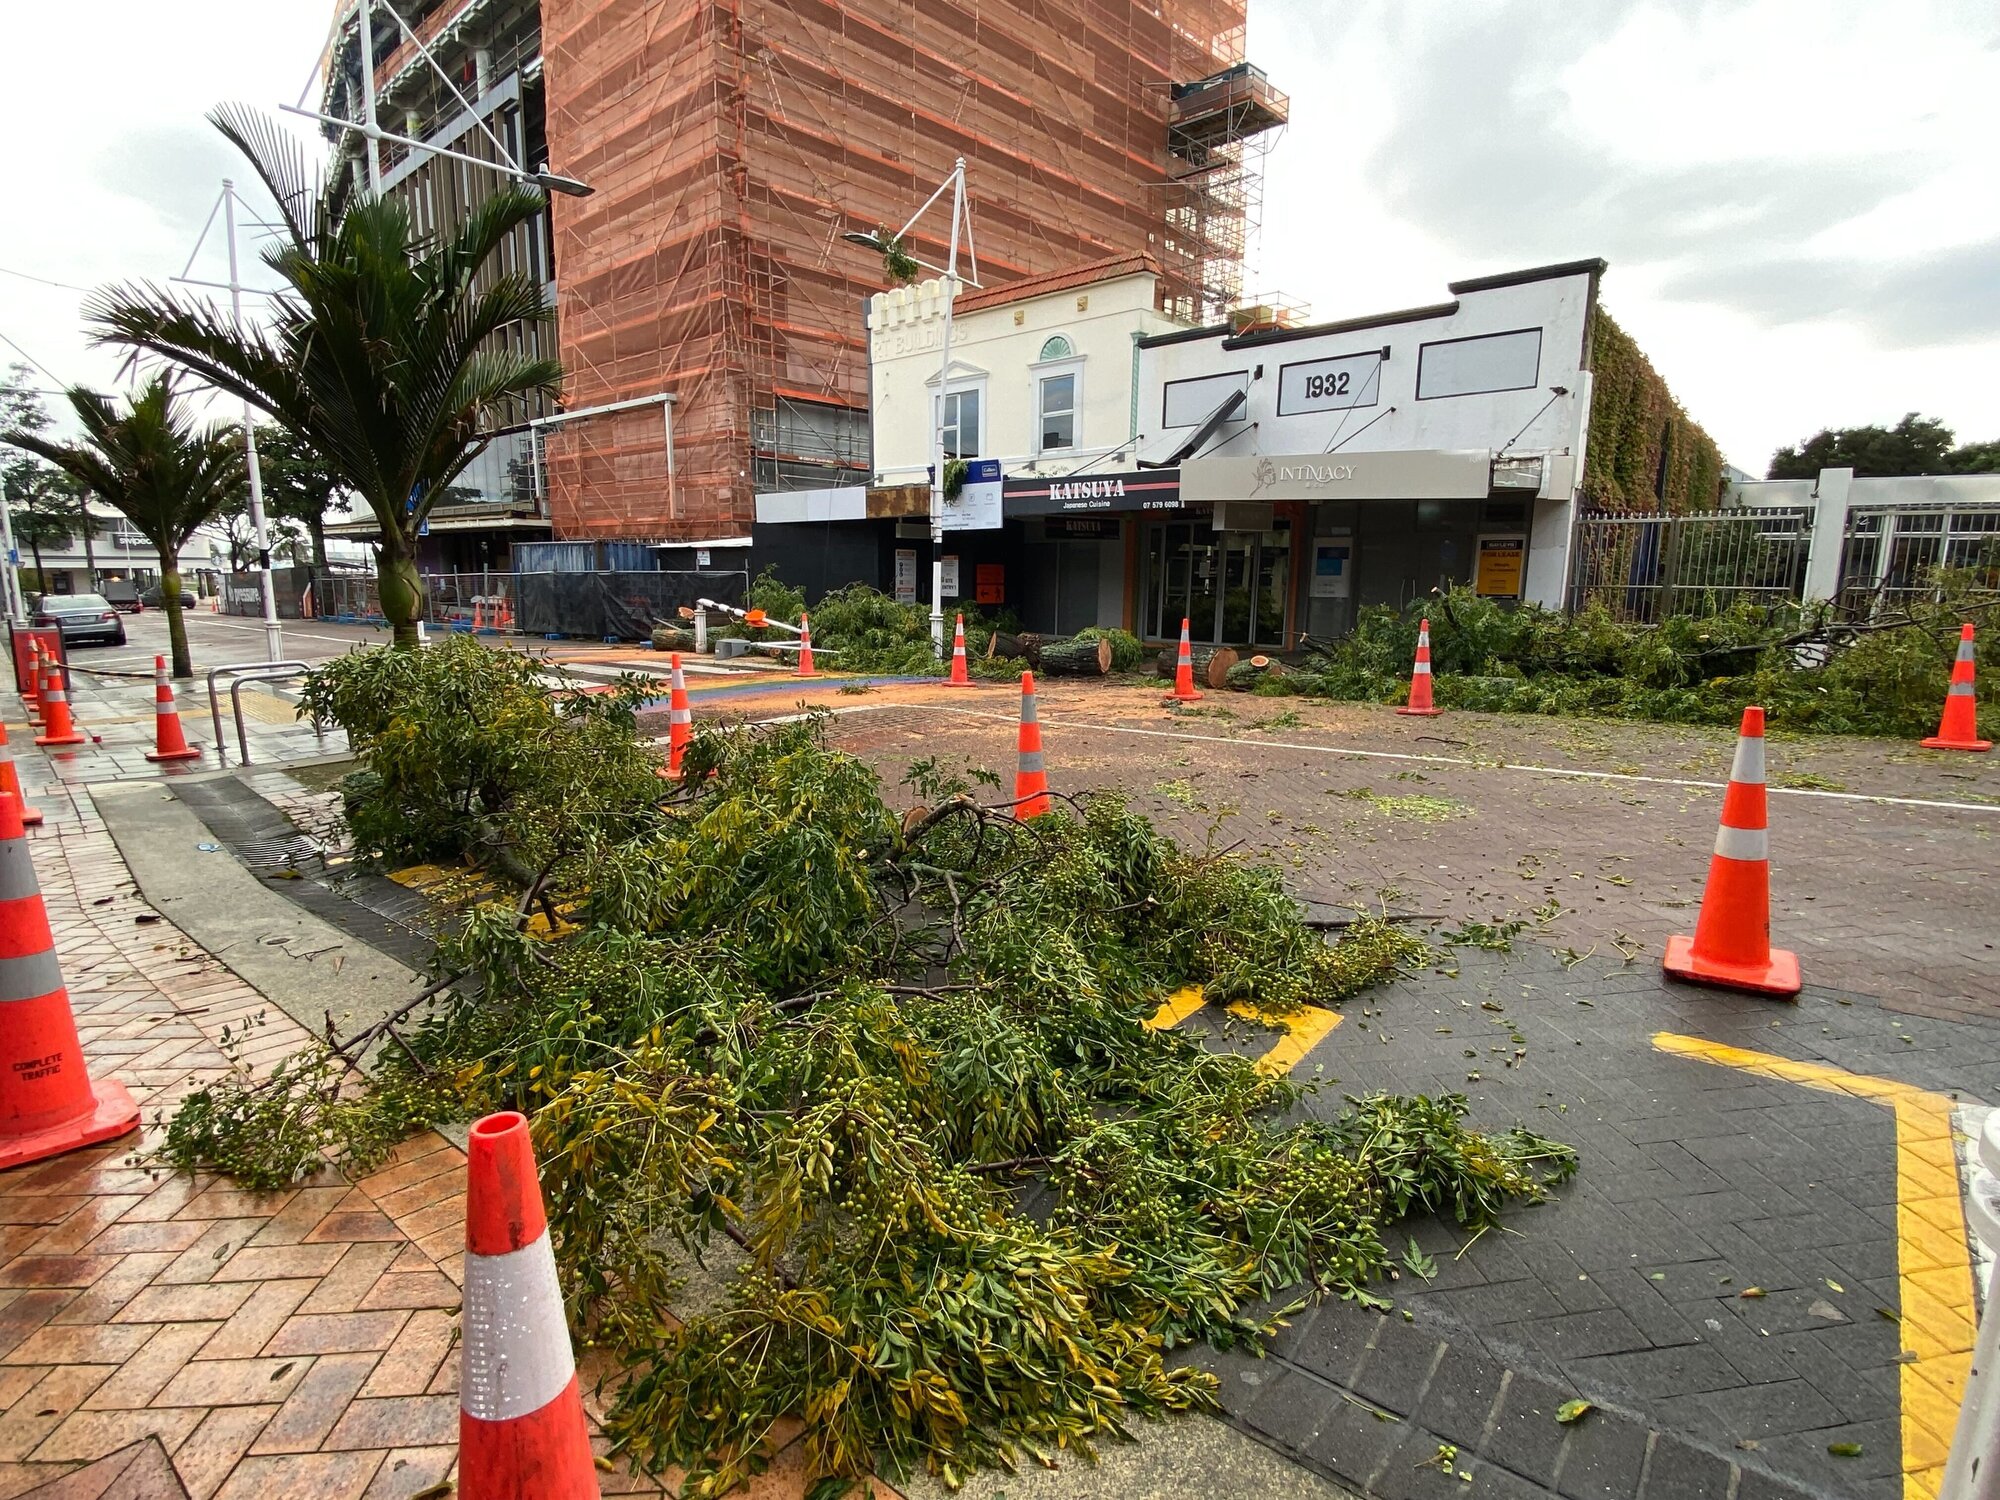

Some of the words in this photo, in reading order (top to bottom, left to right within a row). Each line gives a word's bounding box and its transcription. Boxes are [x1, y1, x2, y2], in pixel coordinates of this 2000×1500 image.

[1305, 372, 1350, 399] 1932
[1280, 465, 1357, 483] INTIMACY
[1049, 479, 1126, 500] KATSUYA
[1152, 501, 1163, 509] 579
[1164, 500, 1179, 508] 6098
[13, 1053, 62, 1072] COMPLETE
[22, 1065, 61, 1080] TRAFFIC
